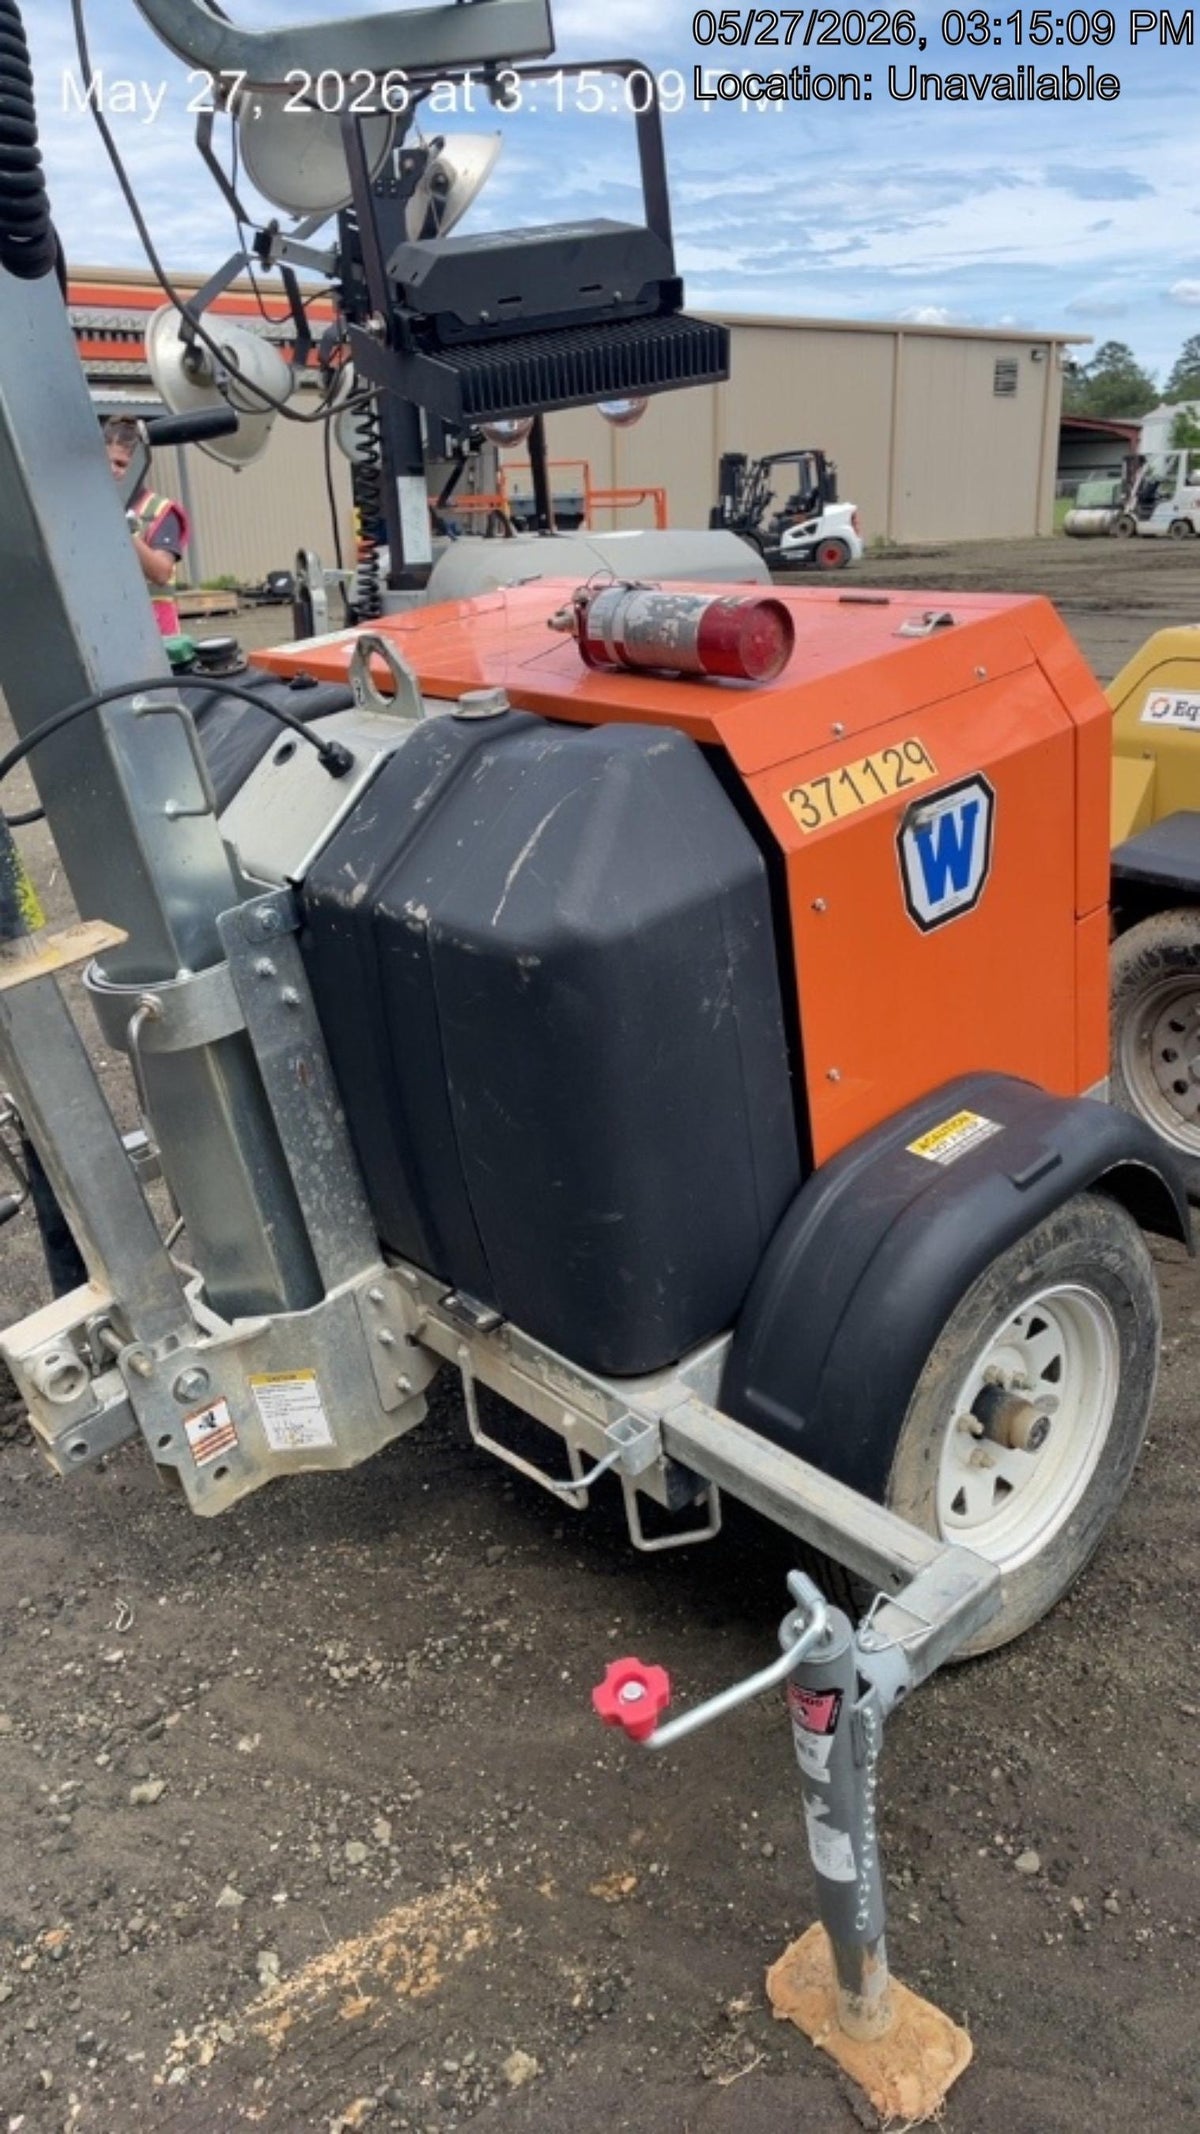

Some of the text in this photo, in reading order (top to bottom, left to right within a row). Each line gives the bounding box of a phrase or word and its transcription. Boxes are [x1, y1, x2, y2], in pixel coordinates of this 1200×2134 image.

[1173, 700, 1200, 721] Eq
[788, 740, 935, 828] 371129
[912, 799, 980, 906] W
